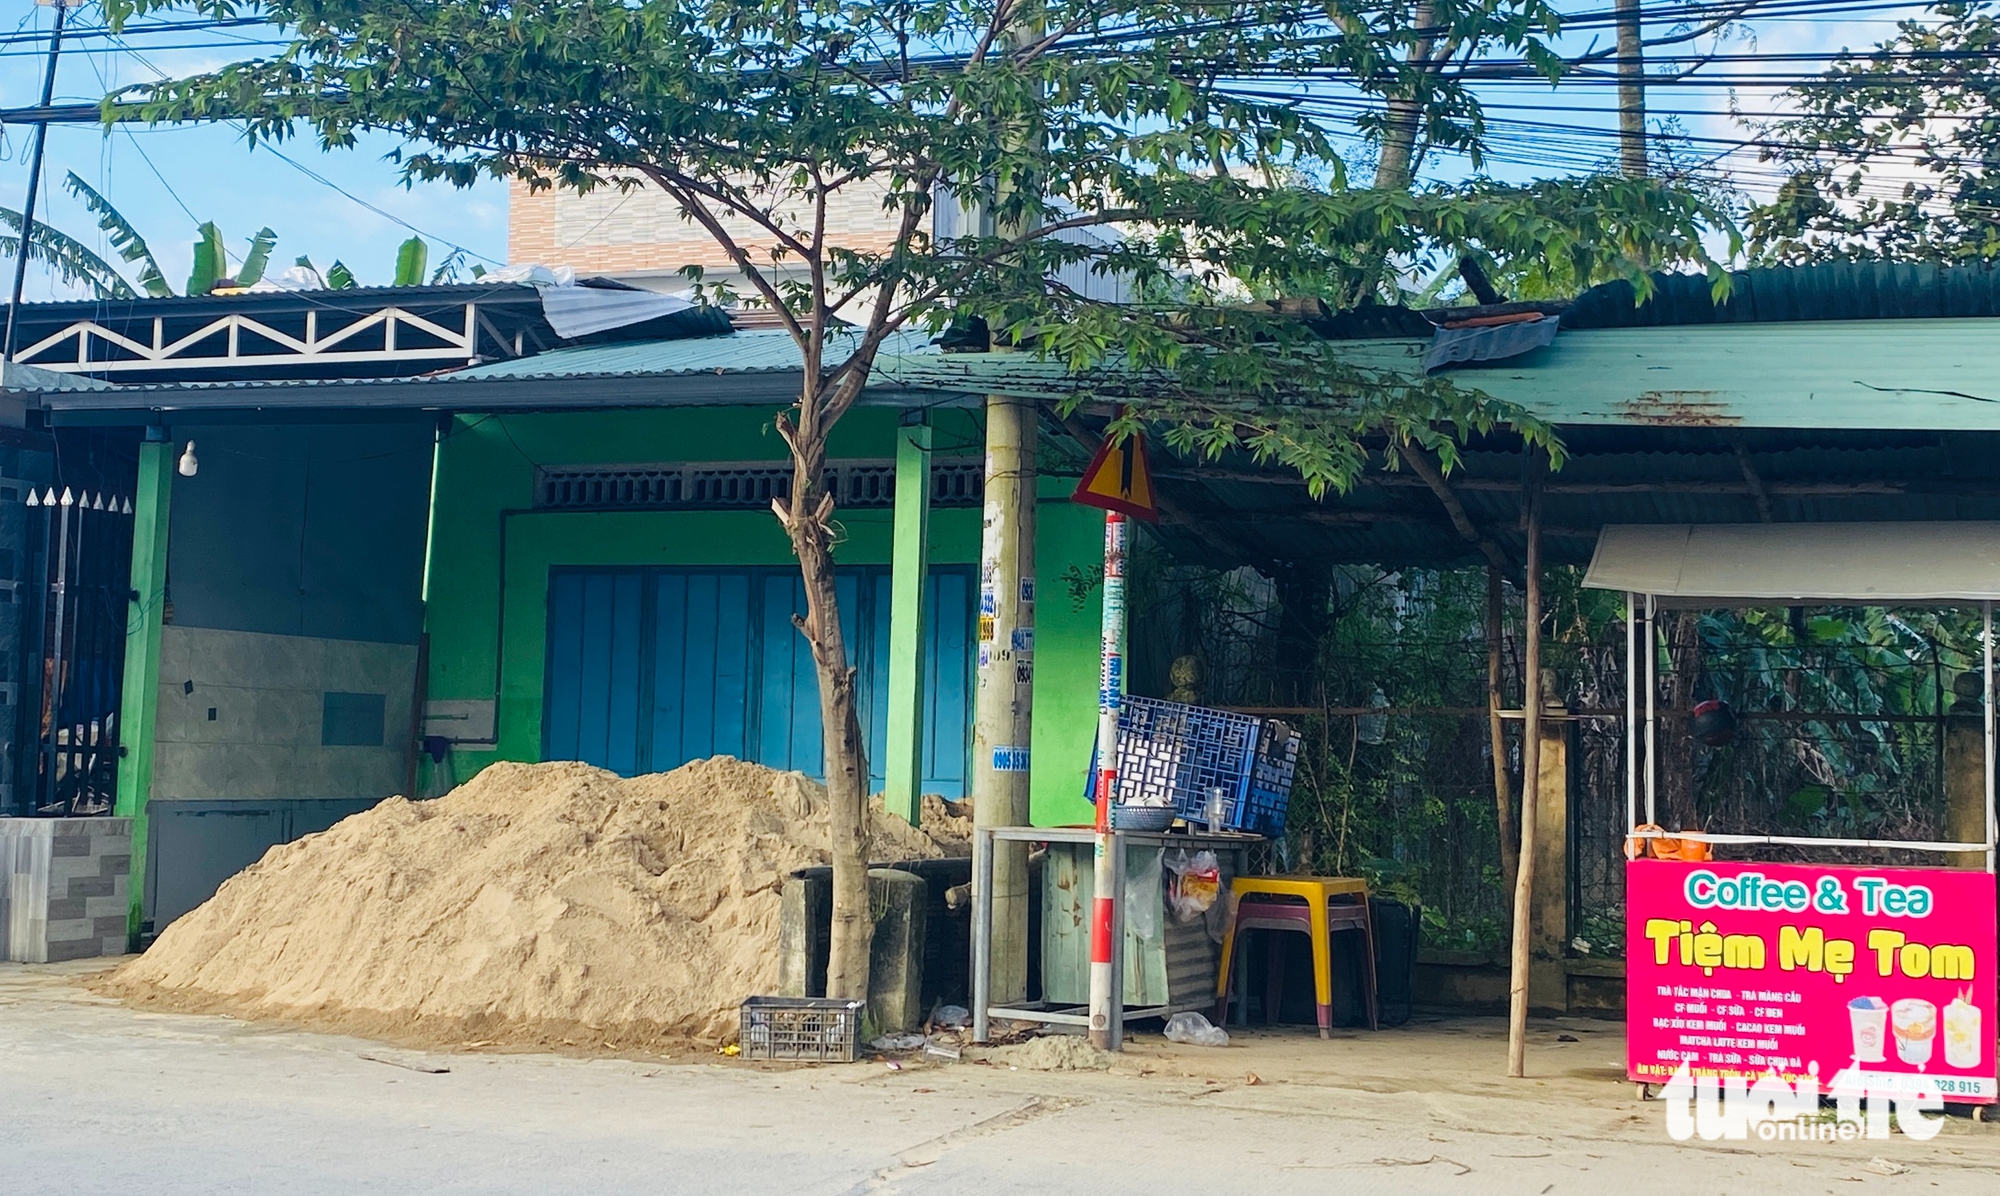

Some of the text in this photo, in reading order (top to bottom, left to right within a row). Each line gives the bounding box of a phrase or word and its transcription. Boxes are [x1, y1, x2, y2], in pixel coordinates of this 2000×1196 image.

[1686, 871, 1931, 916] Coffee & Tea
[1645, 918, 1976, 985] Tiệm Mẹ Tom
[1674, 1003, 1685, 1013] CF
[1717, 1005, 1727, 1015] CF
[1754, 1007, 1764, 1017] CF
[1959, 1081, 1981, 1094] 915
